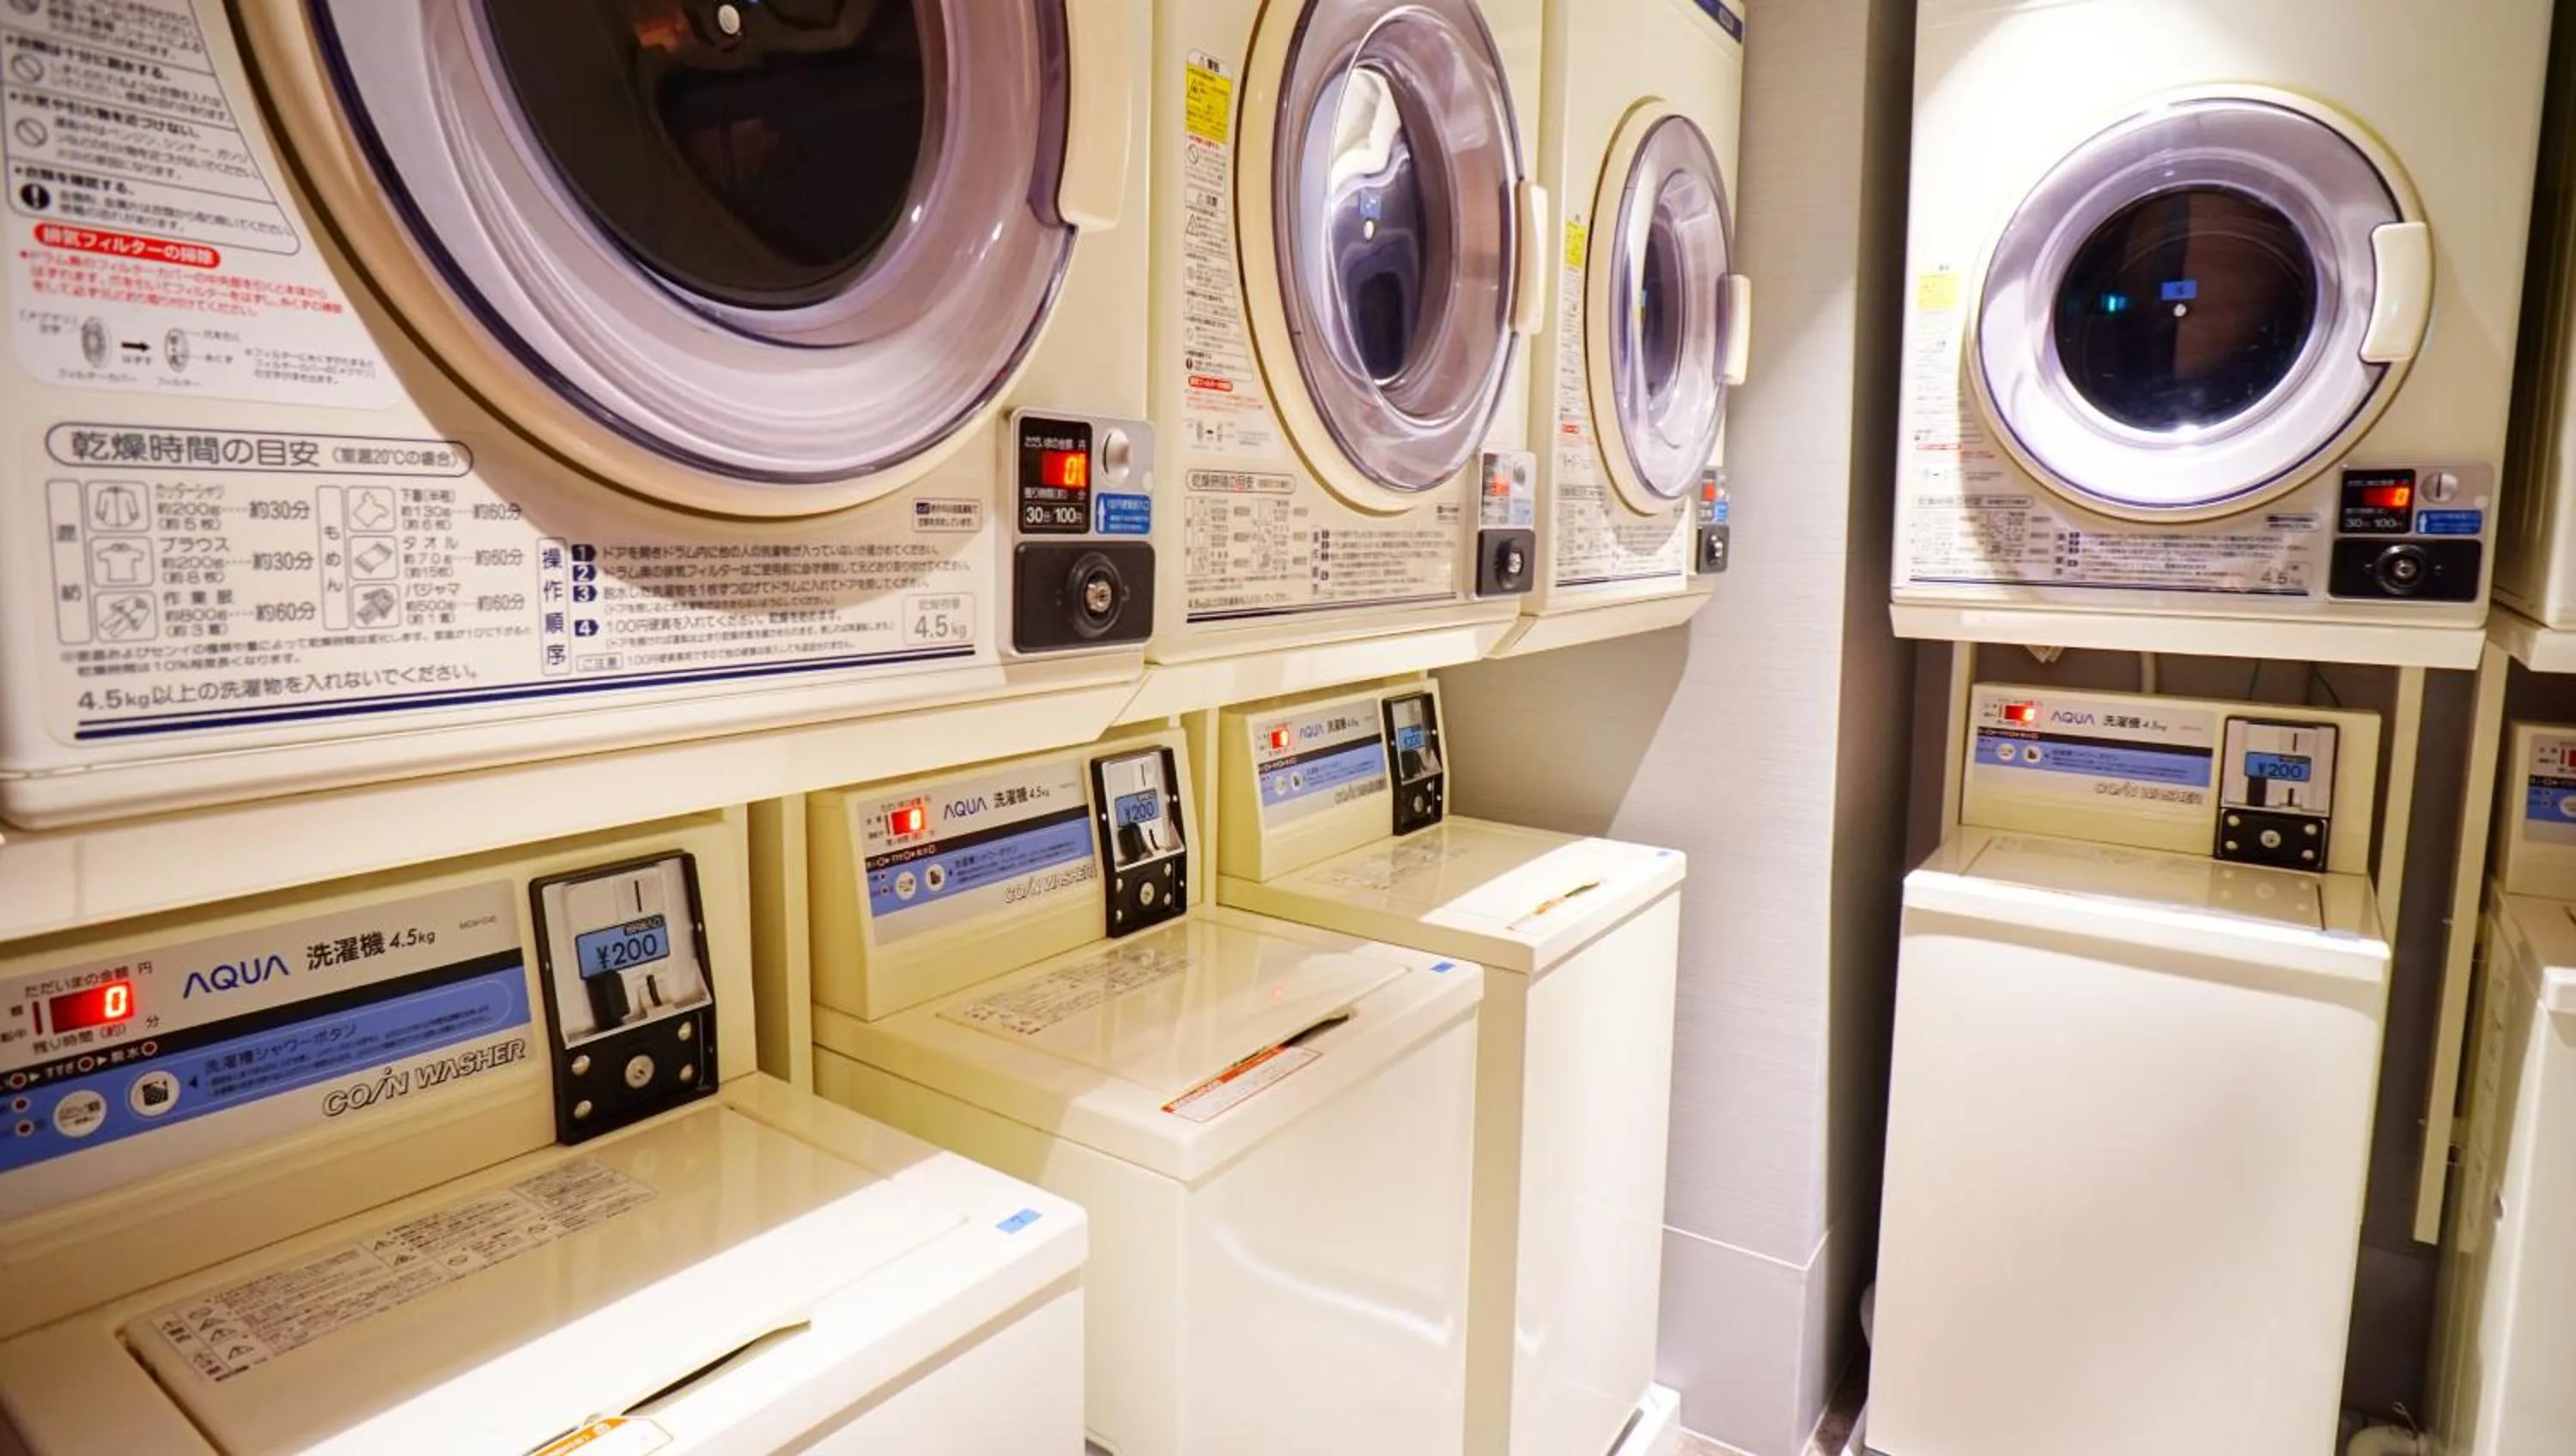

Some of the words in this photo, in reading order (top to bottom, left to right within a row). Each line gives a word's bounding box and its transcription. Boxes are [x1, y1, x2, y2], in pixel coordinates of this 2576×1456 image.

[70, 429, 321, 468] 乾燥時間の目安
[249, 500, 311, 519] 約30分
[473, 502, 522, 520] 約60分
[159, 537, 230, 553] ブラウス
[403, 537, 459, 550] タオル
[252, 551, 313, 571] 約30分
[324, 525, 342, 592] もめん
[475, 549, 523, 566] 約60分
[405, 582, 460, 597] パジャマ
[257, 602, 316, 622] 約60分
[477, 594, 525, 611] 約60分
[542, 548, 566, 665] 操作順序
[2051, 710, 2094, 725] AQUA
[2257, 761, 2303, 779] ¥200
[944, 796, 987, 820] AQUA
[1125, 801, 1154, 821] ¥200
[597, 933, 657, 969] ¥200
[137, 962, 153, 975] 円
[182, 955, 289, 999] AQUA
[306, 931, 386, 971] 洗濯機
[388, 928, 435, 949] 4.5kg
[104, 986, 128, 1018] 0
[146, 1016, 161, 1029] 分
[323, 1065, 410, 1118] COIN
[416, 1037, 526, 1091] WASHER
